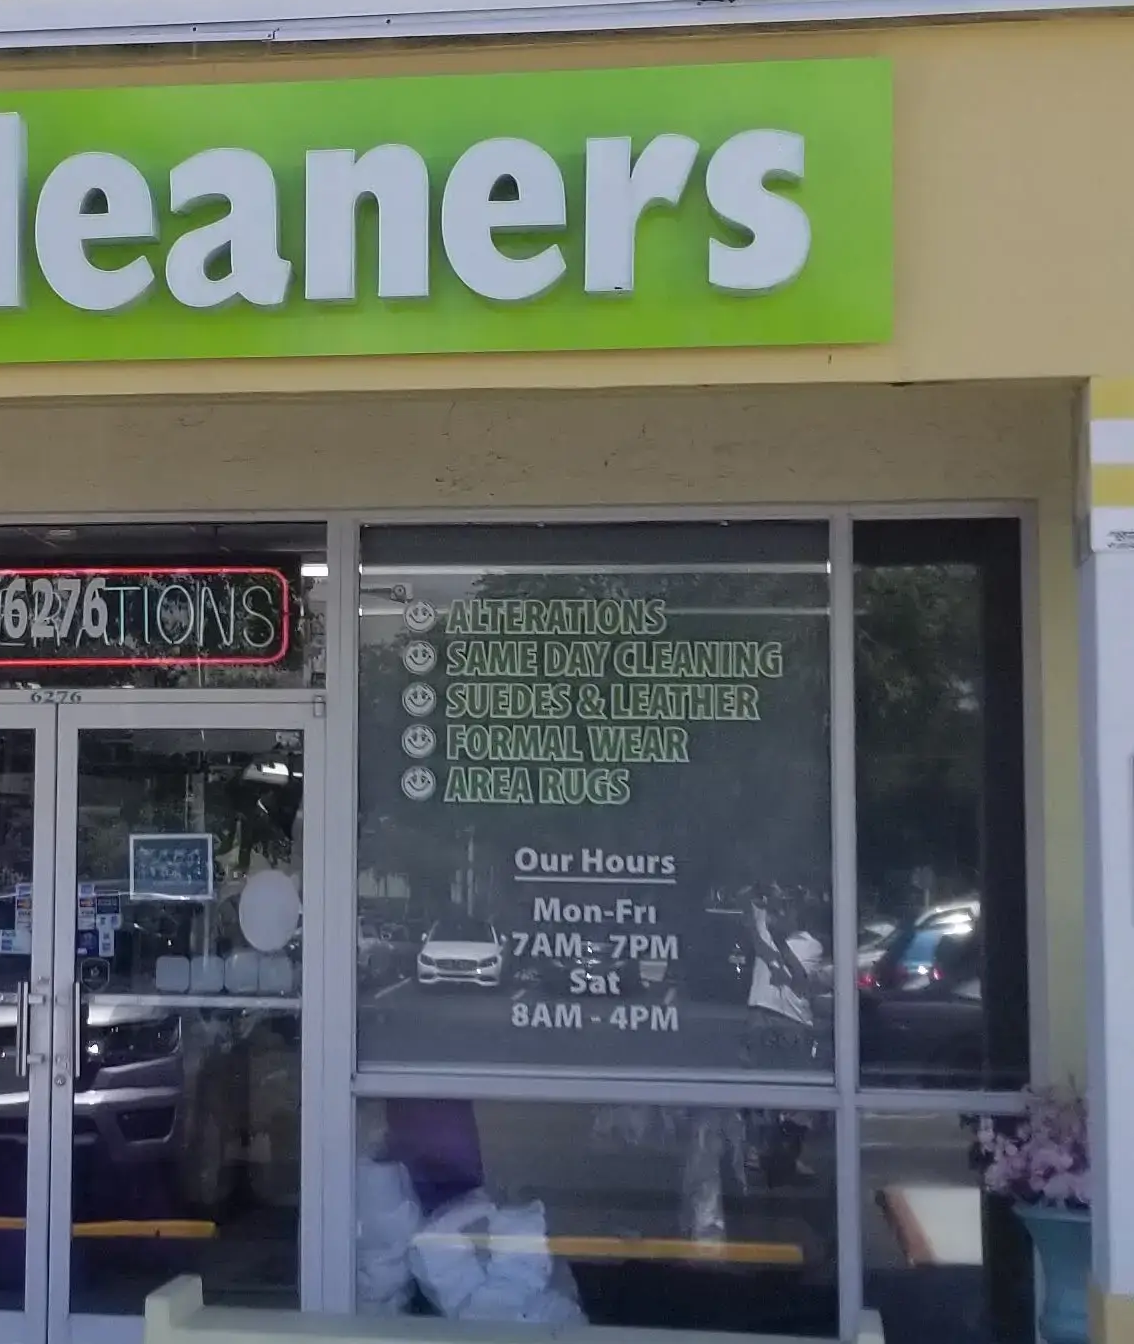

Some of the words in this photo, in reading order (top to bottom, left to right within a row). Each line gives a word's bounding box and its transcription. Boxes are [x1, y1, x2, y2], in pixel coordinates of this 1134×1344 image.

[3, 578, 109, 639] 6276
[445, 599, 666, 635] ALTERATIONS
[446, 641, 538, 677] SAME
[544, 642, 610, 677] DAY
[613, 642, 783, 678] CLEANING
[30, 691, 82, 704] 6276
[445, 683, 571, 719] SUEDES
[577, 684, 608, 720] &
[610, 684, 761, 720] LEATHER
[445, 725, 584, 762] FORMAL
[587, 726, 690, 763] WEAR
[443, 767, 534, 804] AREA
[539, 768, 631, 804] RUGS
[515, 847, 574, 872] Our
[581, 848, 675, 875] Hours
[533, 897, 657, 925] Mon-Fri
[512, 931, 583, 958] 7AM
[609, 934, 679, 960] 7PM
[570, 969, 621, 995] Sat
[512, 1002, 583, 1029] 8AM
[609, 1005, 679, 1032] 4PM
